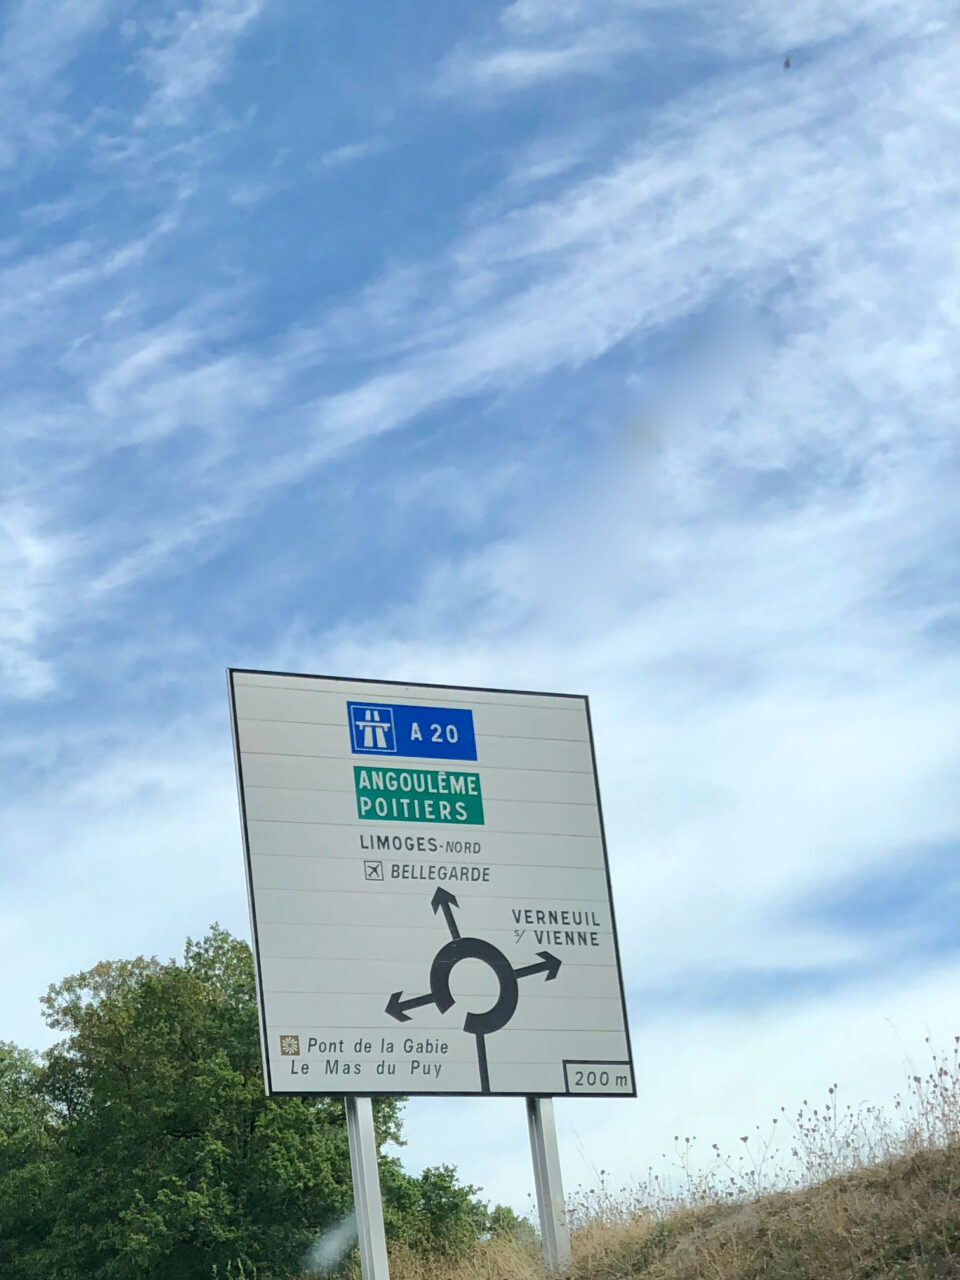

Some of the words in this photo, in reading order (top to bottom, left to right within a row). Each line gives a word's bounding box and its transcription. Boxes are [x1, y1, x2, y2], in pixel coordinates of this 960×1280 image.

[410, 722, 423, 741] A
[430, 723, 459, 744] 20
[359, 770, 479, 796] ANGOULÊME
[360, 796, 468, 821] POITIERS
[360, 834, 481, 854] LIMOGES-NORD
[391, 864, 490, 882] BELLEGARDE
[512, 909, 600, 926] VERNEUIL
[534, 930, 600, 946] VIENNE
[308, 1037, 344, 1053] Pont
[354, 1038, 372, 1053] de
[381, 1038, 394, 1053] la
[403, 1038, 449, 1054] Gabie
[291, 1060, 309, 1075] Le
[325, 1060, 361, 1075] Mas
[376, 1060, 396, 1075] du
[411, 1060, 442, 1079] Puy
[575, 1071, 609, 1087] 200
[615, 1075, 628, 1087] m
